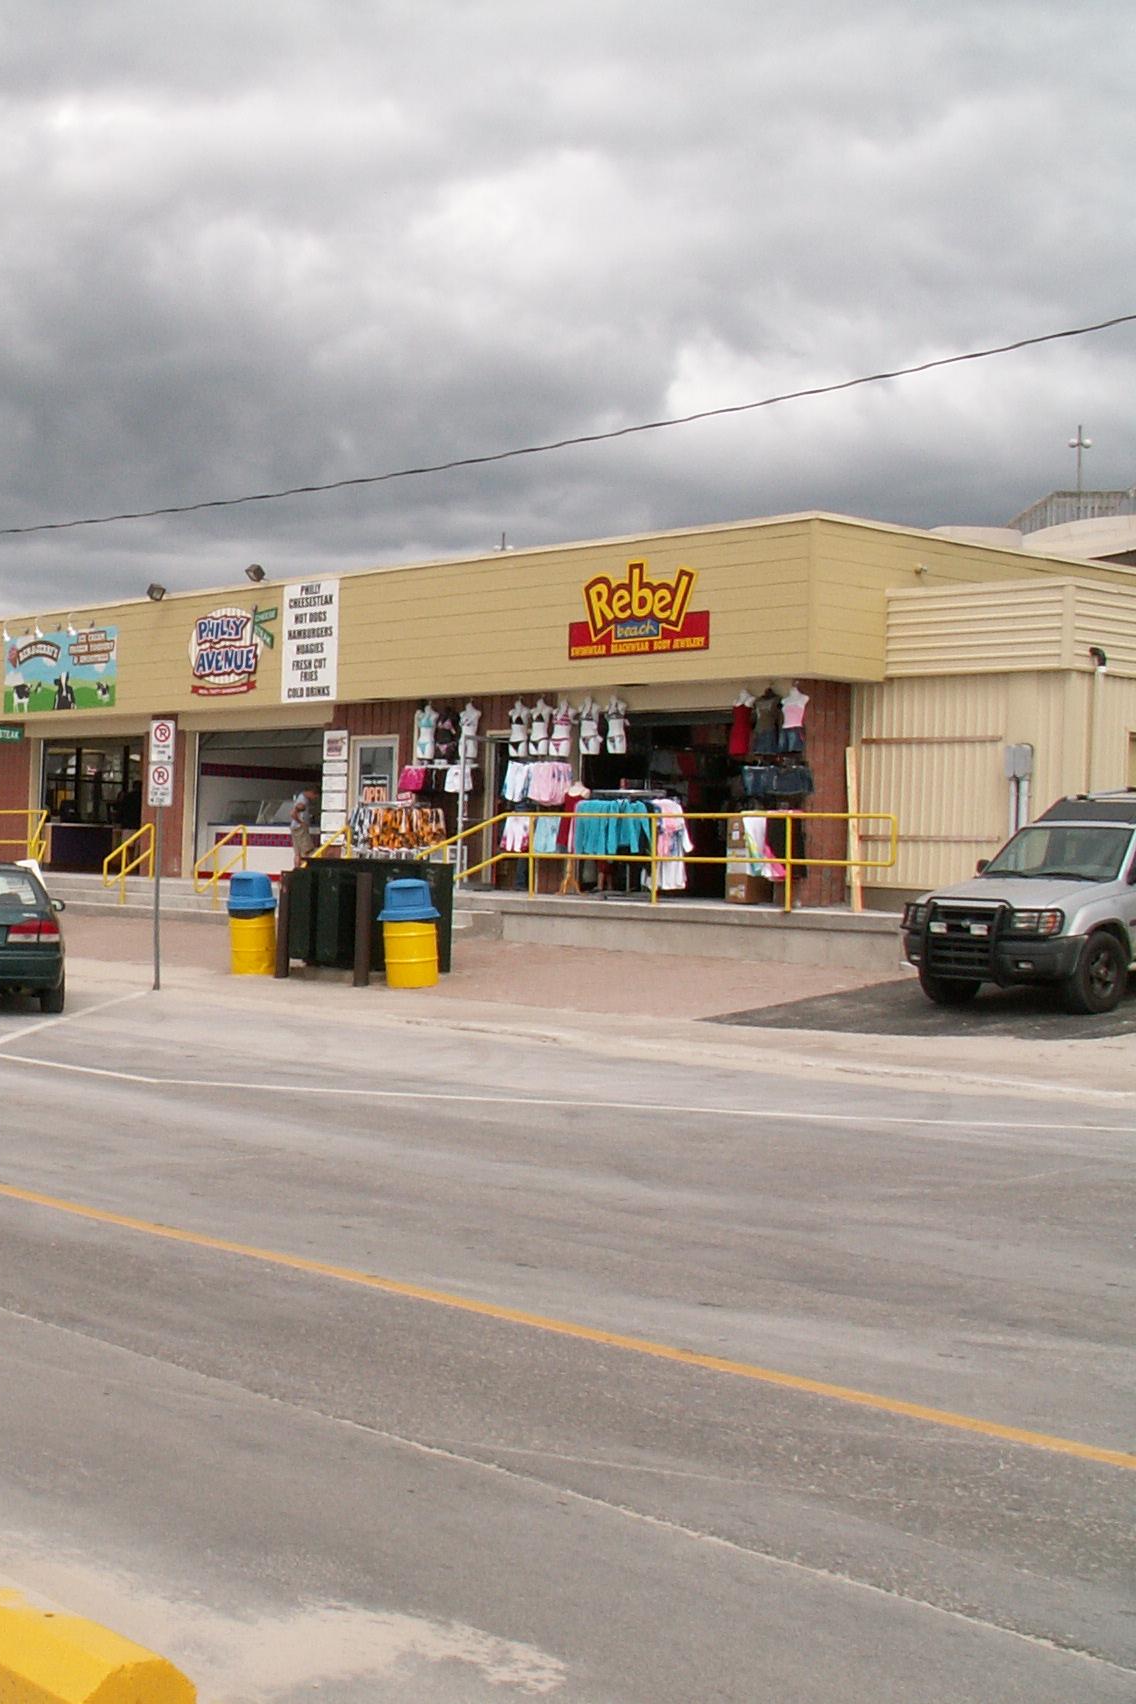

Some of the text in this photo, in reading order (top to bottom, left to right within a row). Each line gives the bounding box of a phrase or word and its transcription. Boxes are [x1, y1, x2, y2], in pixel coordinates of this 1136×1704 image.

[300, 583, 321, 596] PHILLY
[288, 594, 334, 610] CHEESESTEAK
[587, 566, 690, 631] Rebel
[294, 611, 327, 624] HOT DOGS
[288, 626, 333, 640] HAMBURGERS
[616, 620, 657, 638] beach
[296, 642, 324, 655] HOAGIES
[195, 648, 254, 673] AVENUE
[292, 658, 327, 671] FRESH CUT
[300, 670, 318, 682] FRIES
[287, 685, 330, 699] COLD DRINKS
[363, 786, 386, 803] OPEN
